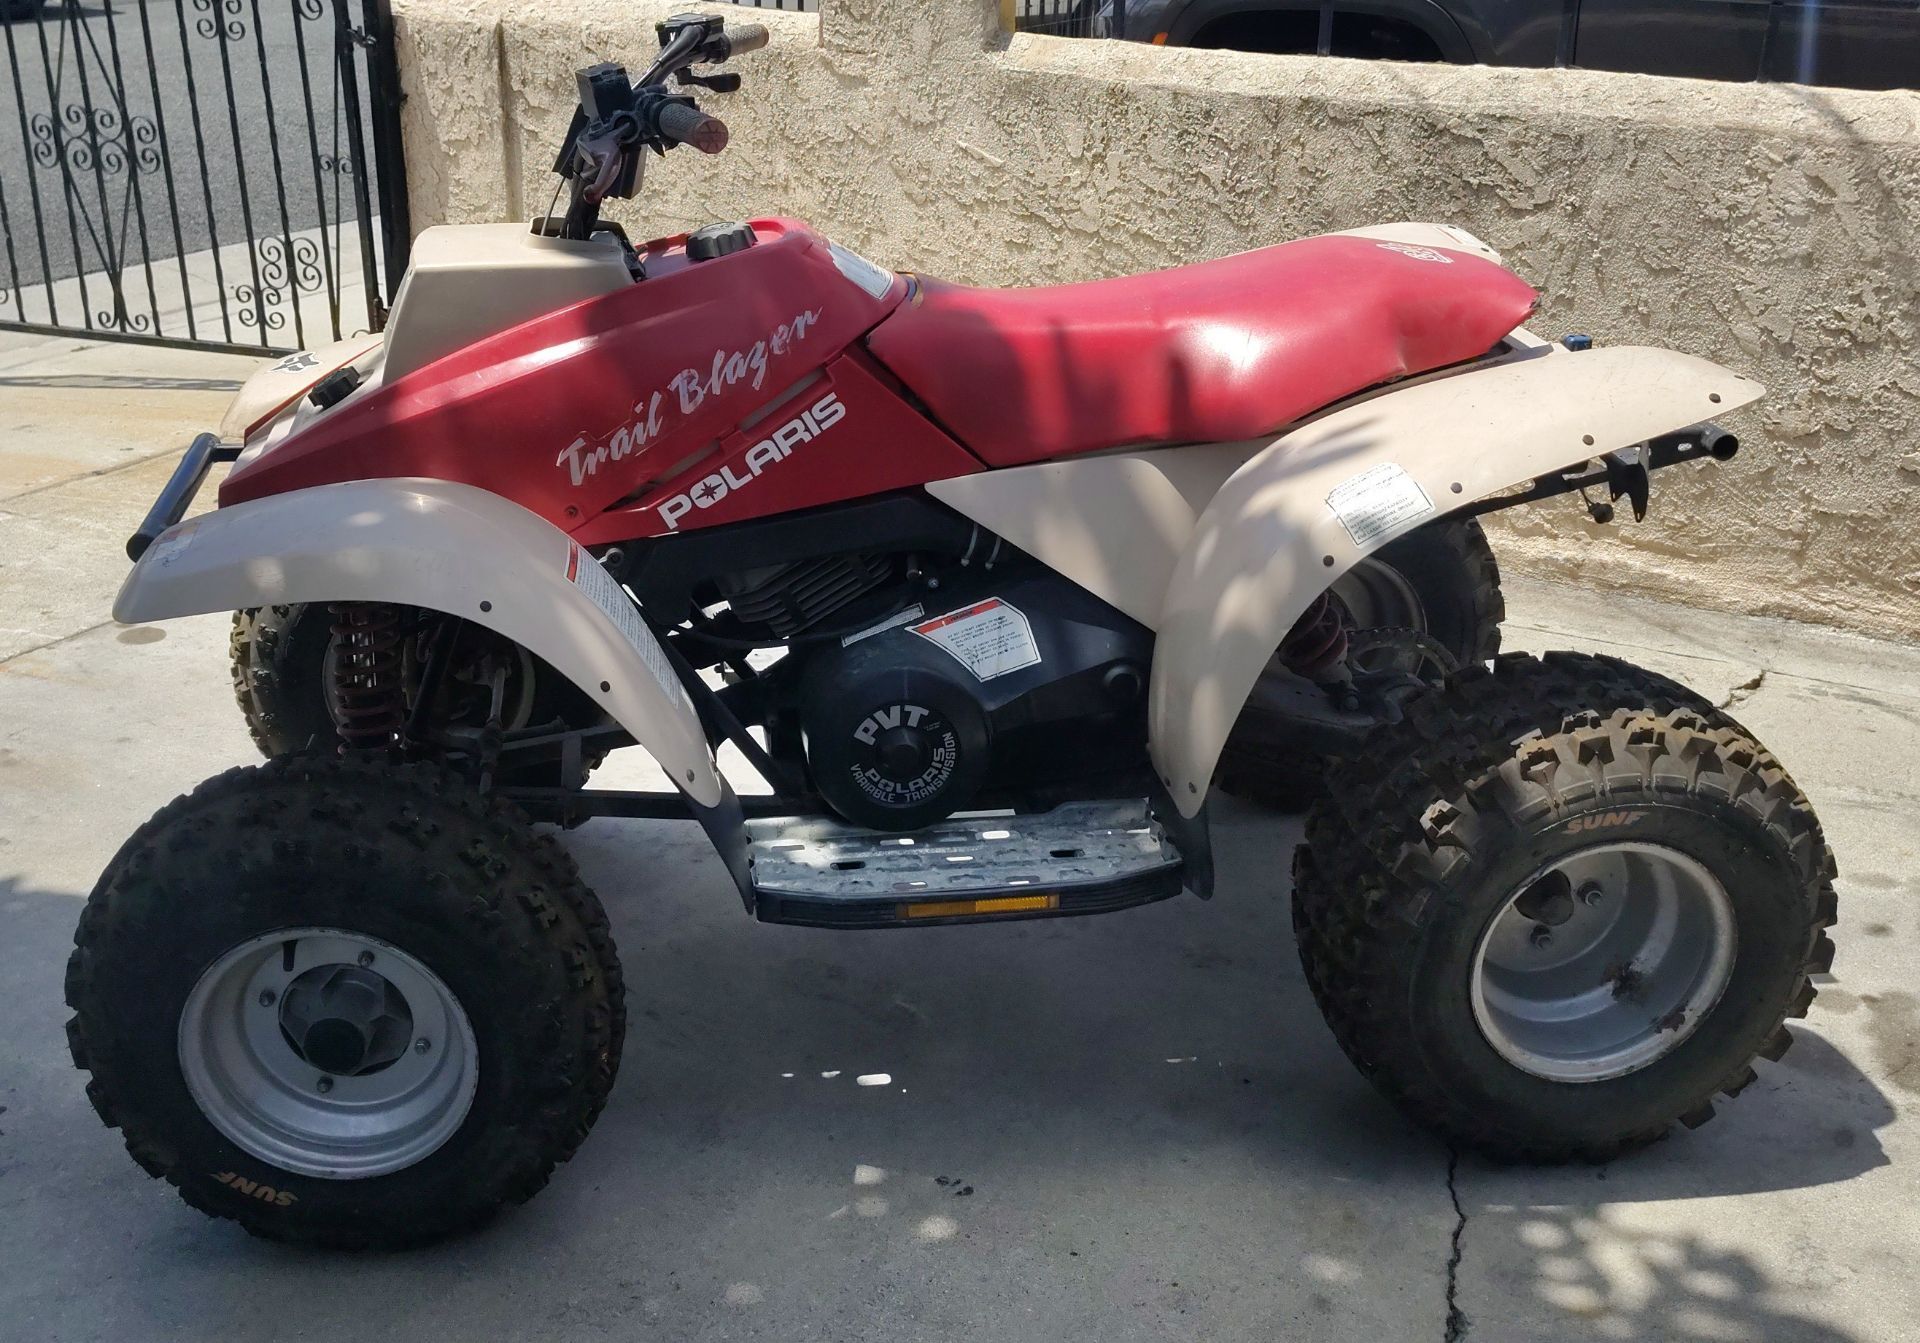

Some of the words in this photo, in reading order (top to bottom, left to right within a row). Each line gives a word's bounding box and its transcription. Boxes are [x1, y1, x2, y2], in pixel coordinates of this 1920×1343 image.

[556, 390, 662, 486] Trail
[667, 306, 824, 415] Blazer
[656, 391, 847, 530] POLARIS
[853, 704, 930, 746] PVT
[850, 763, 896, 803] VARIABLE
[904, 732, 956, 803] TRANSMISSION
[865, 747, 945, 794] POLARIS
[1561, 811, 1650, 834] SUNF
[209, 1171, 299, 1206] SUNF
